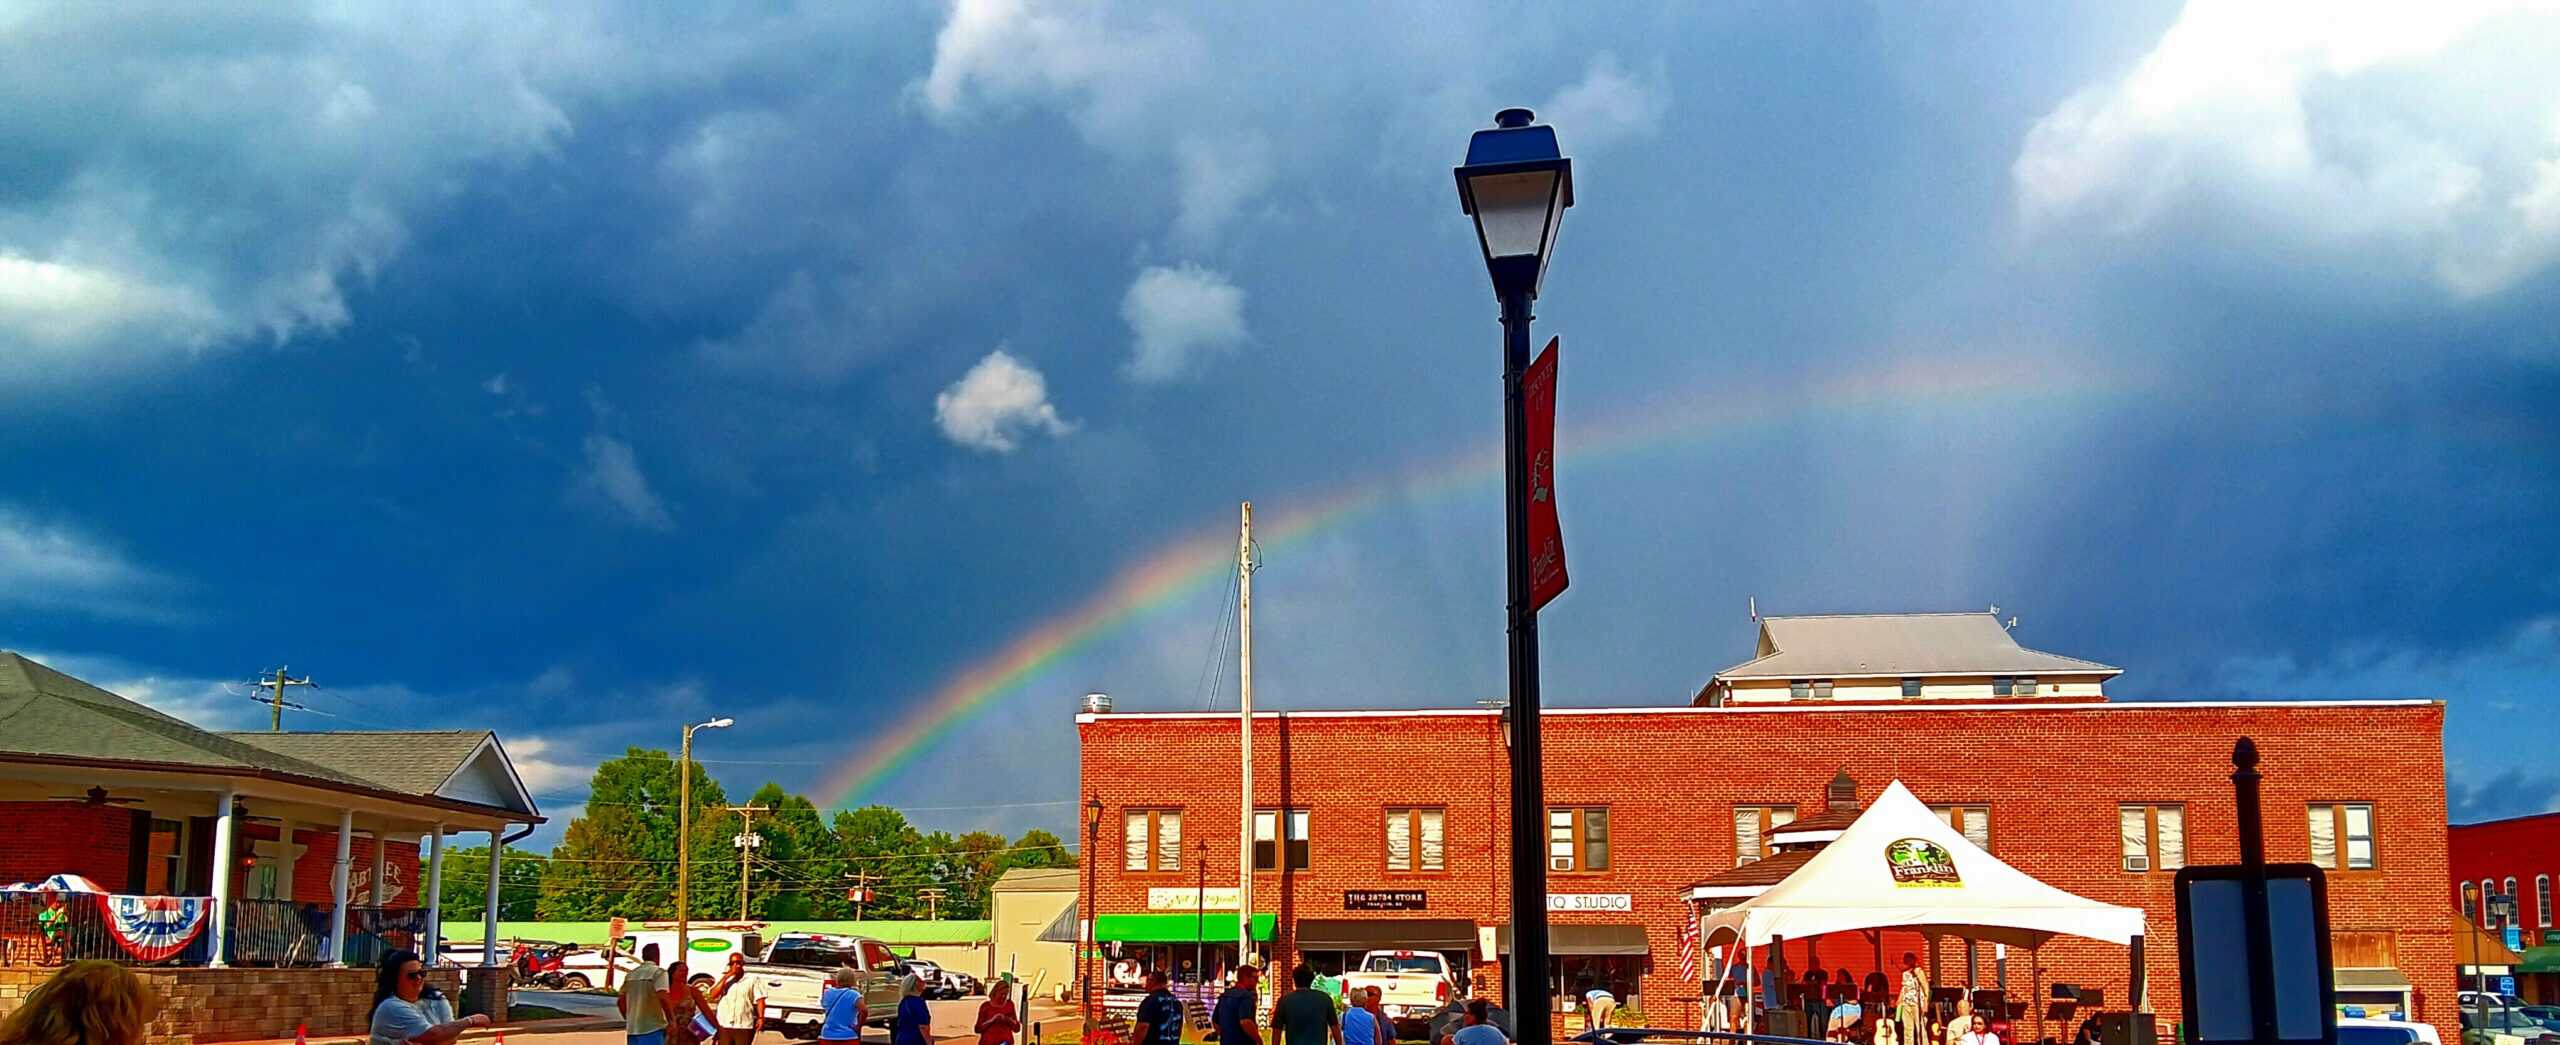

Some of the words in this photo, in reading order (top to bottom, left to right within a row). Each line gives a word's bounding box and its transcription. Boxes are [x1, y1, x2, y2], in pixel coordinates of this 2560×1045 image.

[1891, 863, 1955, 876] Franklin
[1348, 893, 1366, 902] THE
[1368, 893, 1392, 901] 28734
[1394, 893, 1423, 901] STORE
[1575, 896, 1627, 909] STUDIO
